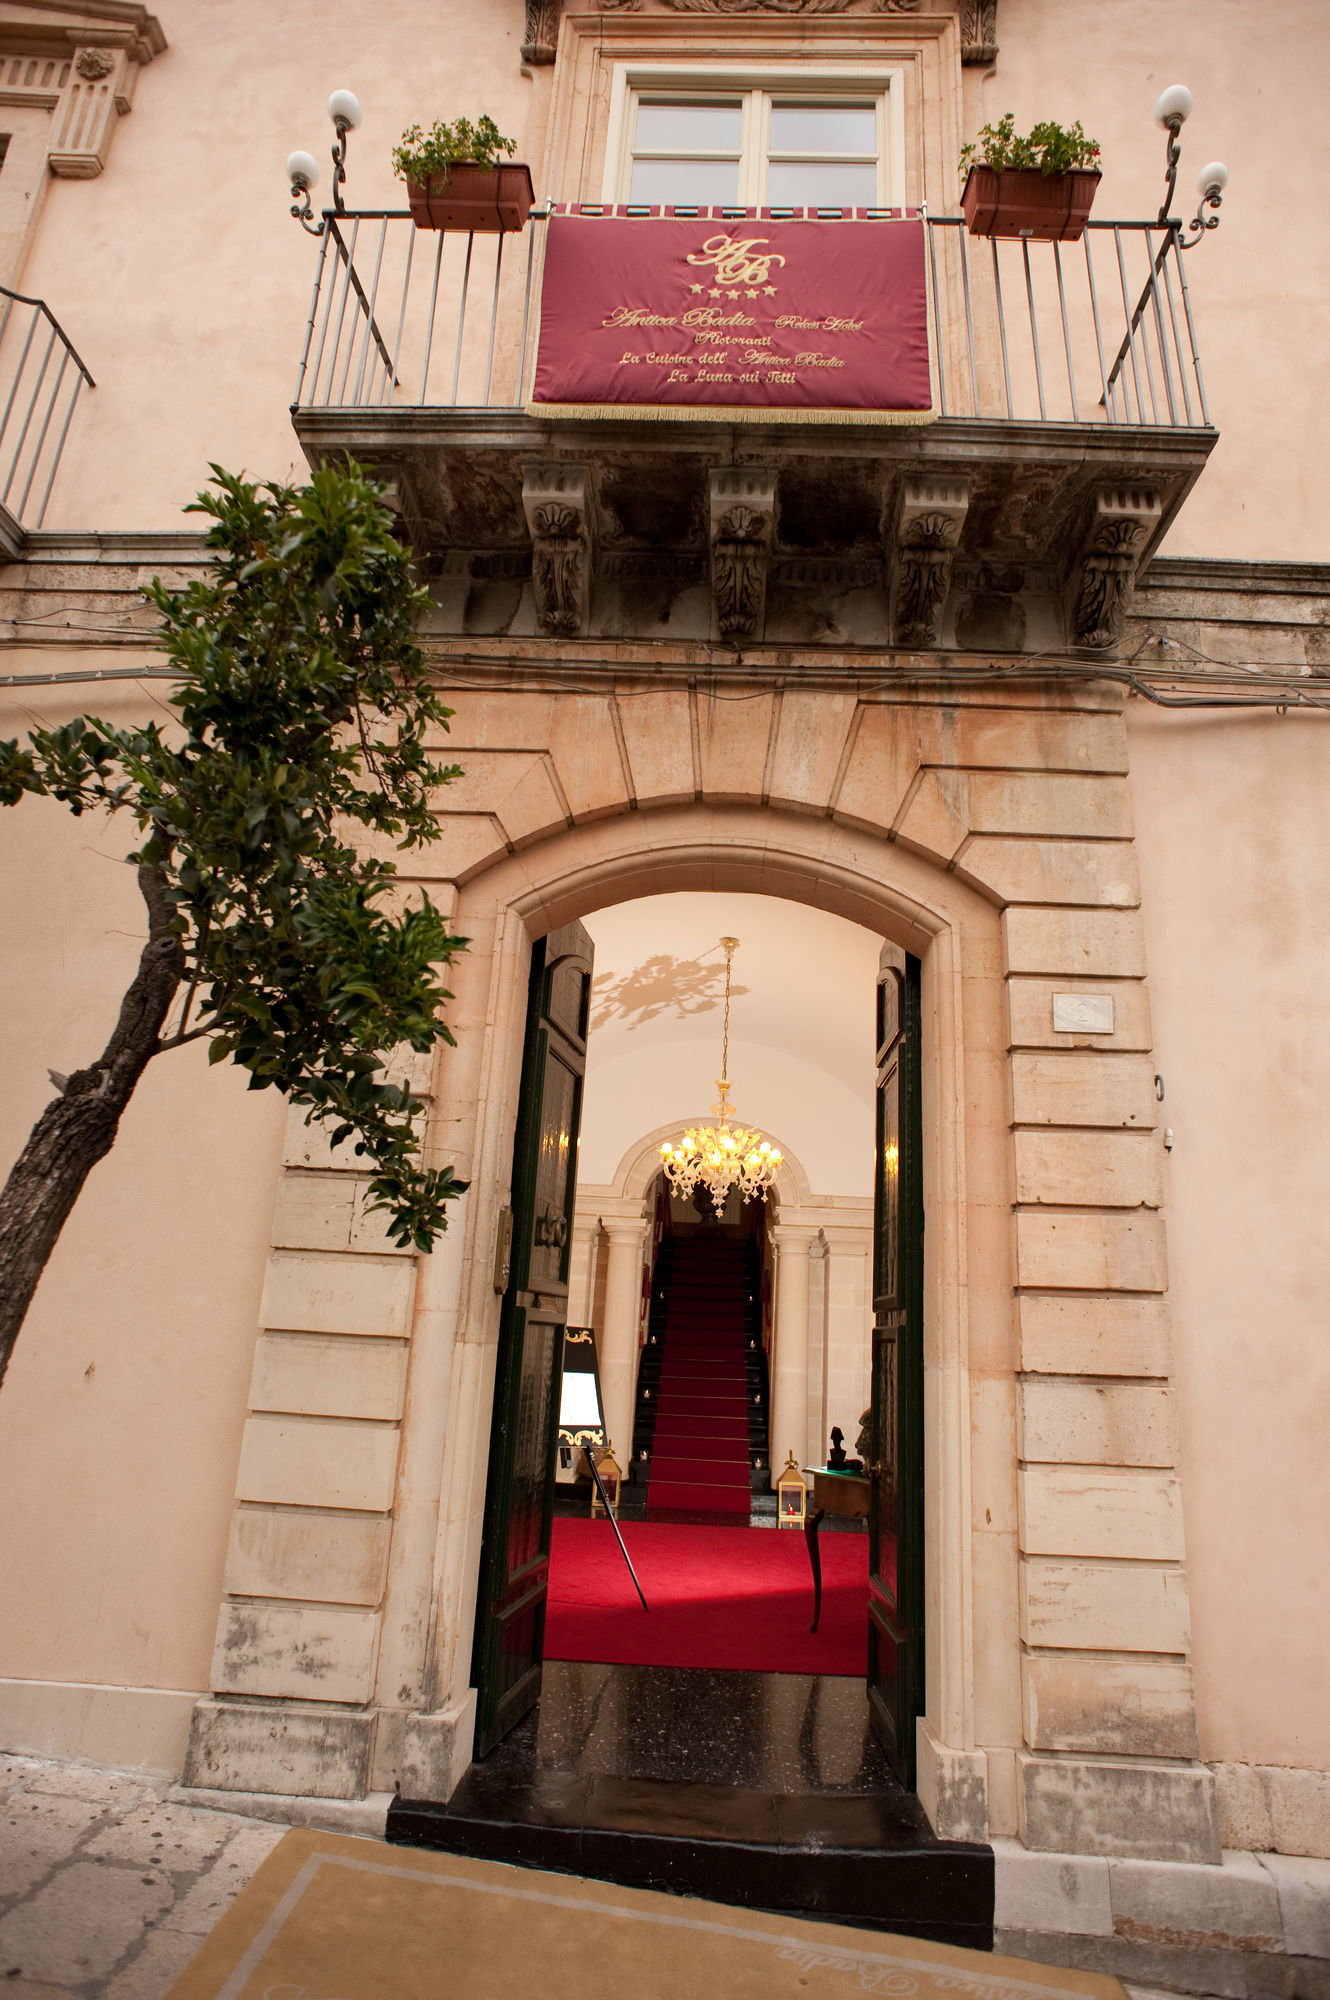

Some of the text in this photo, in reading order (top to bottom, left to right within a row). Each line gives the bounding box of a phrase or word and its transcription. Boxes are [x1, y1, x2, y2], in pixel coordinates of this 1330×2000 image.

[602, 307, 864, 331] Antica Badia Relais Hotel
[694, 330, 771, 345] Ristoranti
[620, 349, 845, 367] La Cuisine dell' Antica Badia
[667, 369, 796, 384] La Luna sui Tetti
[774, 1947, 918, 1996] Badia
